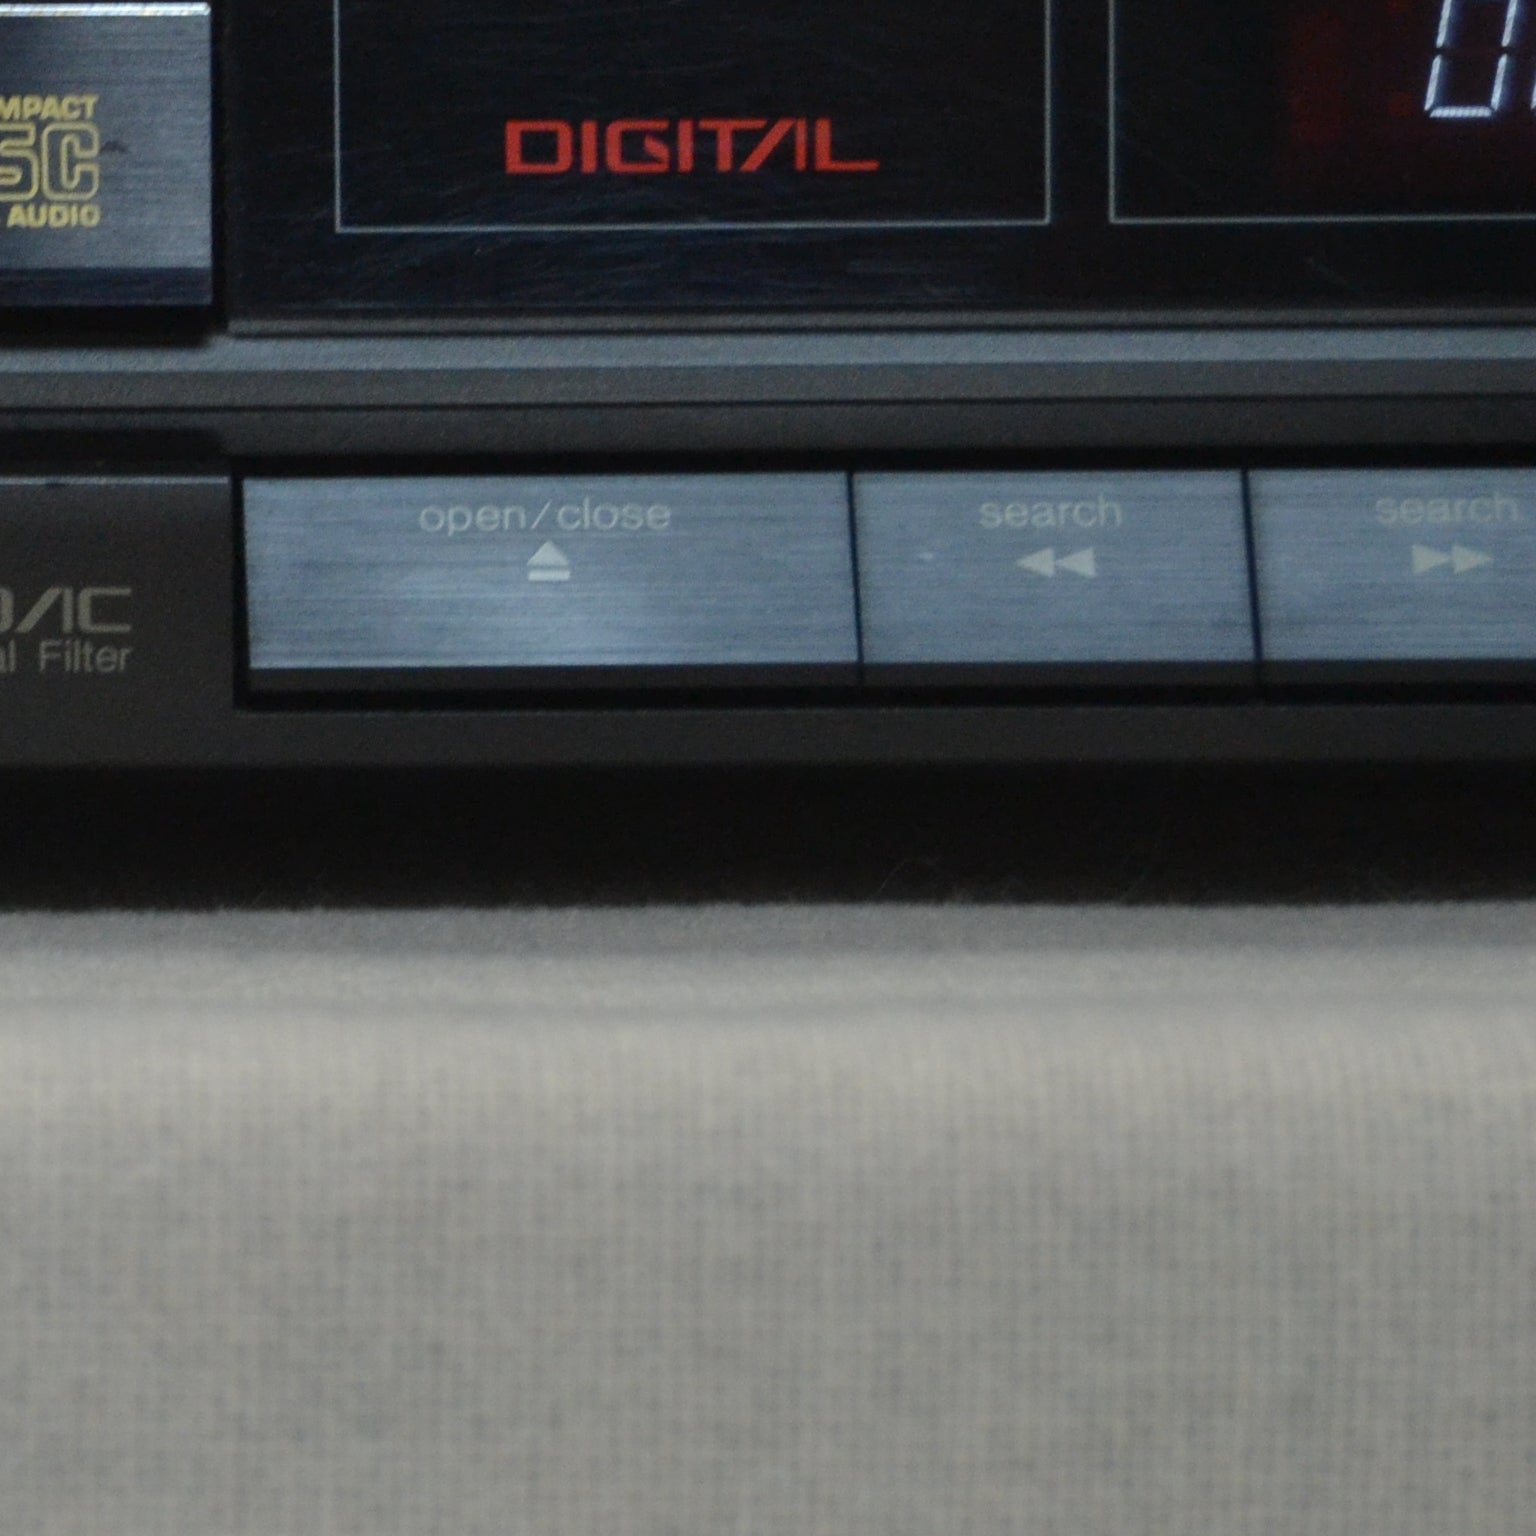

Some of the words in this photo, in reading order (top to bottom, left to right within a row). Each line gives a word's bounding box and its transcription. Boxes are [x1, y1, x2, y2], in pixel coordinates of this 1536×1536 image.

[503, 118, 879, 175] DIGITAL
[6, 204, 102, 228] AUDIO
[418, 496, 673, 537] open/close
[978, 492, 1124, 529] search
[1375, 491, 1520, 526] search
[38, 638, 133, 673] Filter
